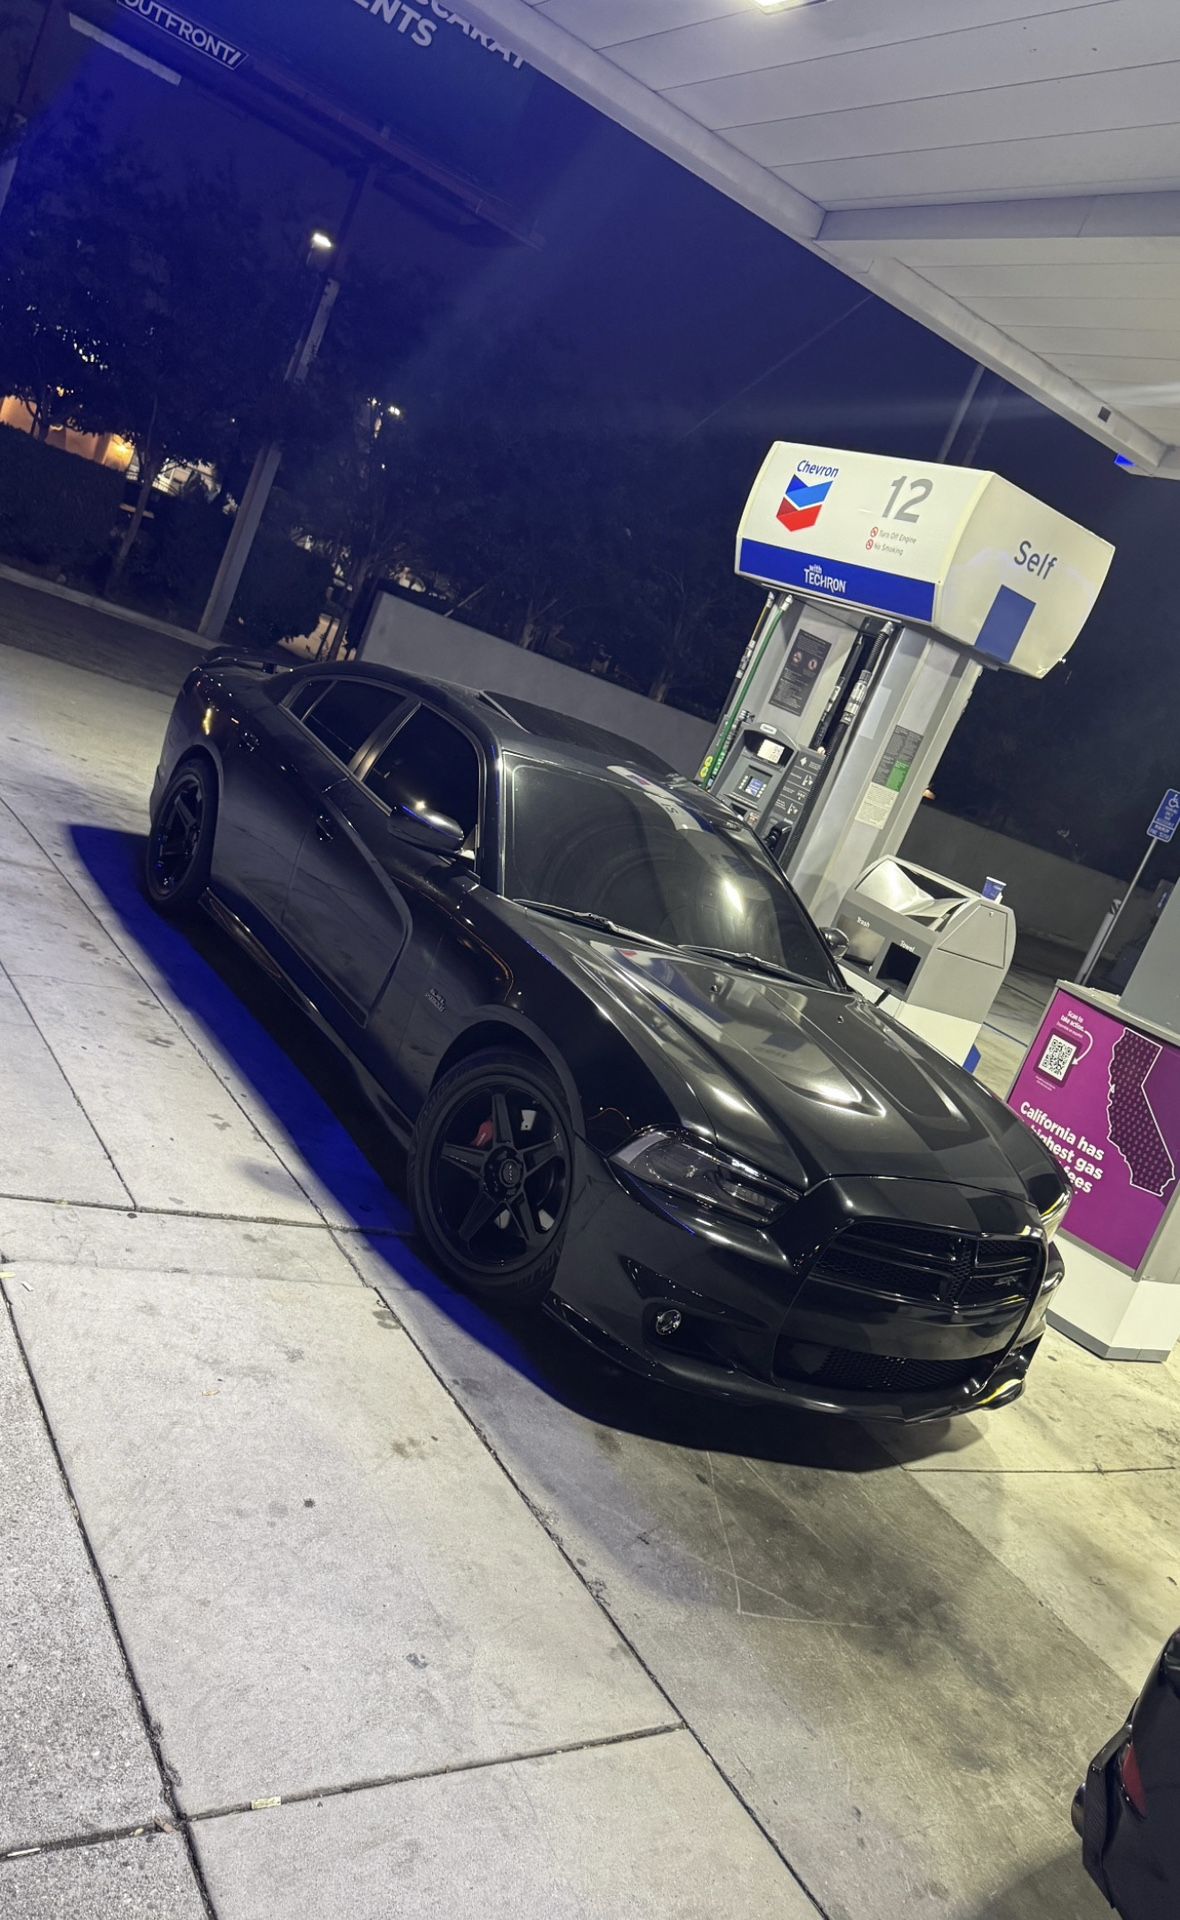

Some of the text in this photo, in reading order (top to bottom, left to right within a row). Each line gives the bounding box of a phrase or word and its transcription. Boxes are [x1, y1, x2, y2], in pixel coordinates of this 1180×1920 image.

[352, 0, 437, 47] NTS
[797, 459, 839, 478] Chevron
[881, 475, 934, 524] 12
[808, 564, 823, 575] with
[1014, 540, 1058, 580] Self
[803, 567, 847, 593] TECHRON
[1020, 1101, 1104, 1161] California has
[1074, 1157, 1104, 1180] gas
